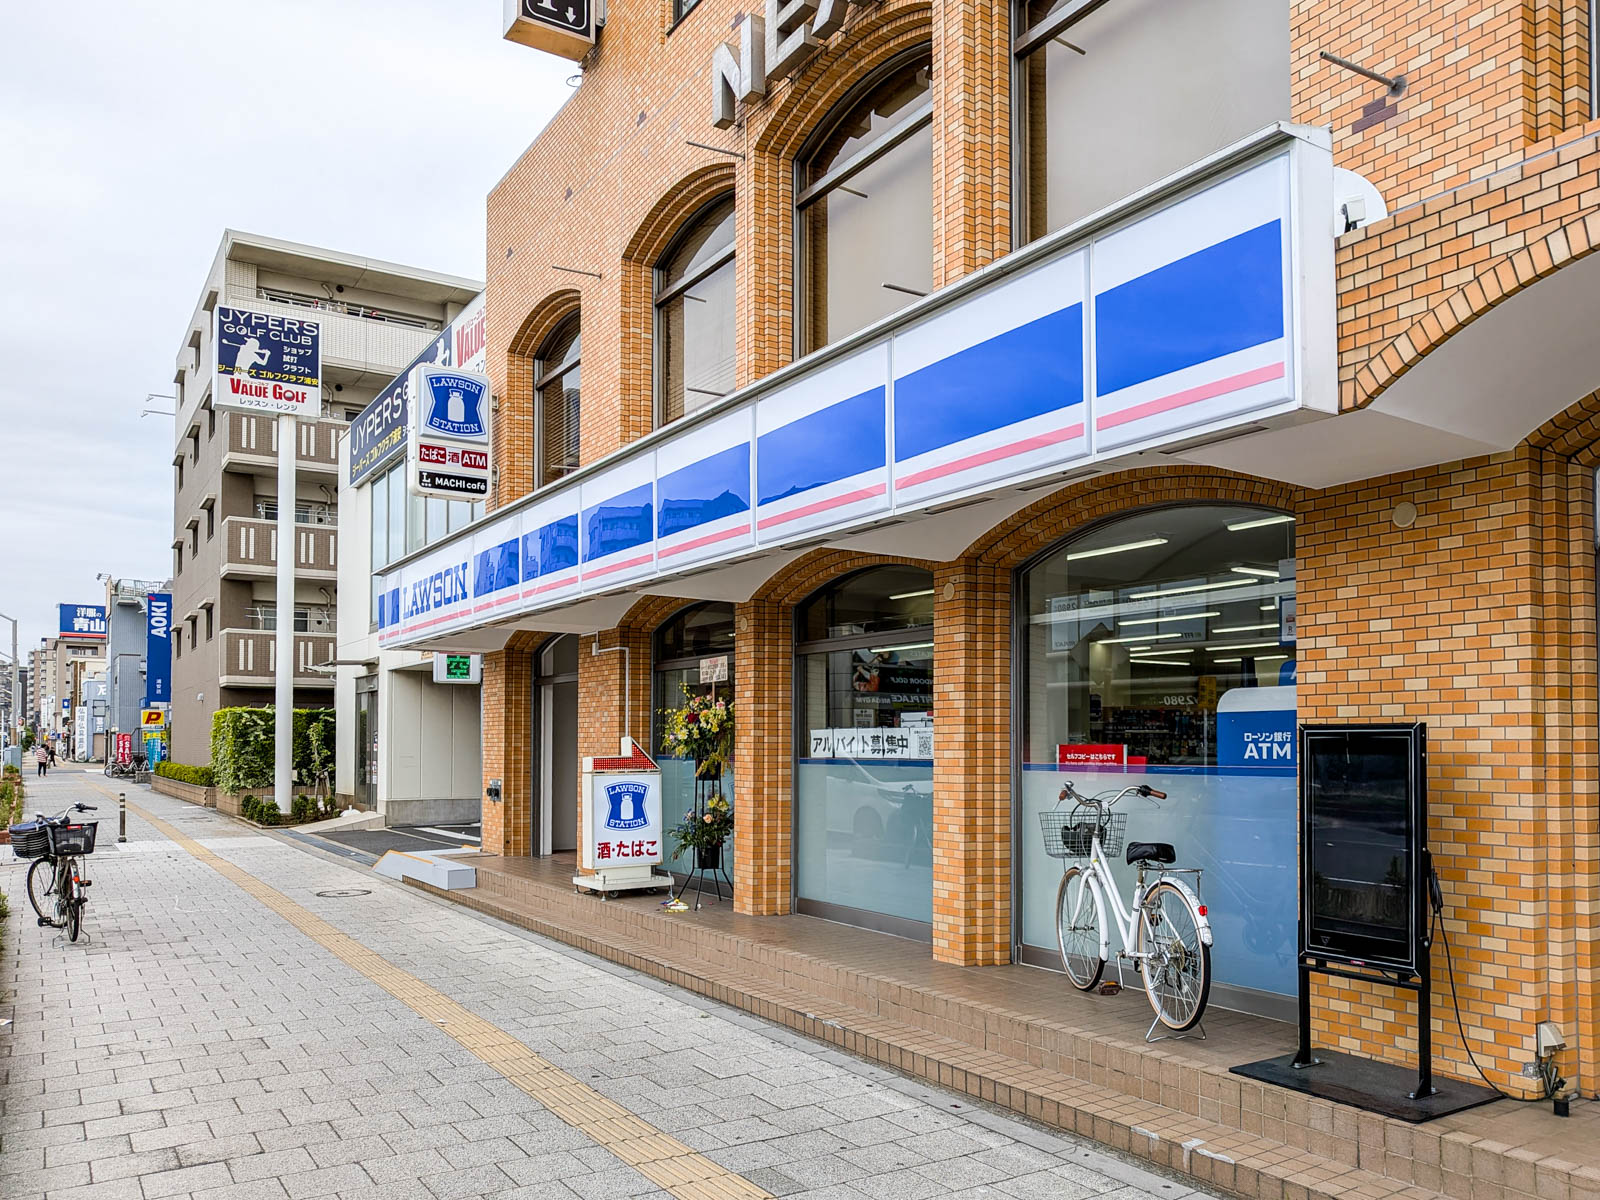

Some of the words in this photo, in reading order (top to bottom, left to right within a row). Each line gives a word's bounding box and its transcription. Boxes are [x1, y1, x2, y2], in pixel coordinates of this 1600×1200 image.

[224, 323, 267, 338] GOLF
[269, 331, 313, 346] CLUB
[456, 316, 486, 369] VALUE
[283, 364, 312, 375] クラフト
[230, 378, 269, 399] VALUE
[272, 384, 308, 404] GOLF
[432, 377, 481, 395] LAWSON
[432, 416, 480, 433] STATION
[420, 447, 446, 462] たばこ
[462, 454, 487, 467] ATM
[435, 477, 466, 489] MACHI
[466, 481, 486, 491] café
[403, 561, 468, 620] LAWSON
[72, 617, 105, 632] 青山
[150, 600, 168, 639] AOKI
[145, 711, 162, 725] P
[813, 734, 909, 755] アルバイト募集中
[1243, 731, 1292, 743] ローソン銀行
[1243, 743, 1292, 760] ATM
[609, 784, 646, 796] LAWSON
[609, 817, 645, 829] STATION
